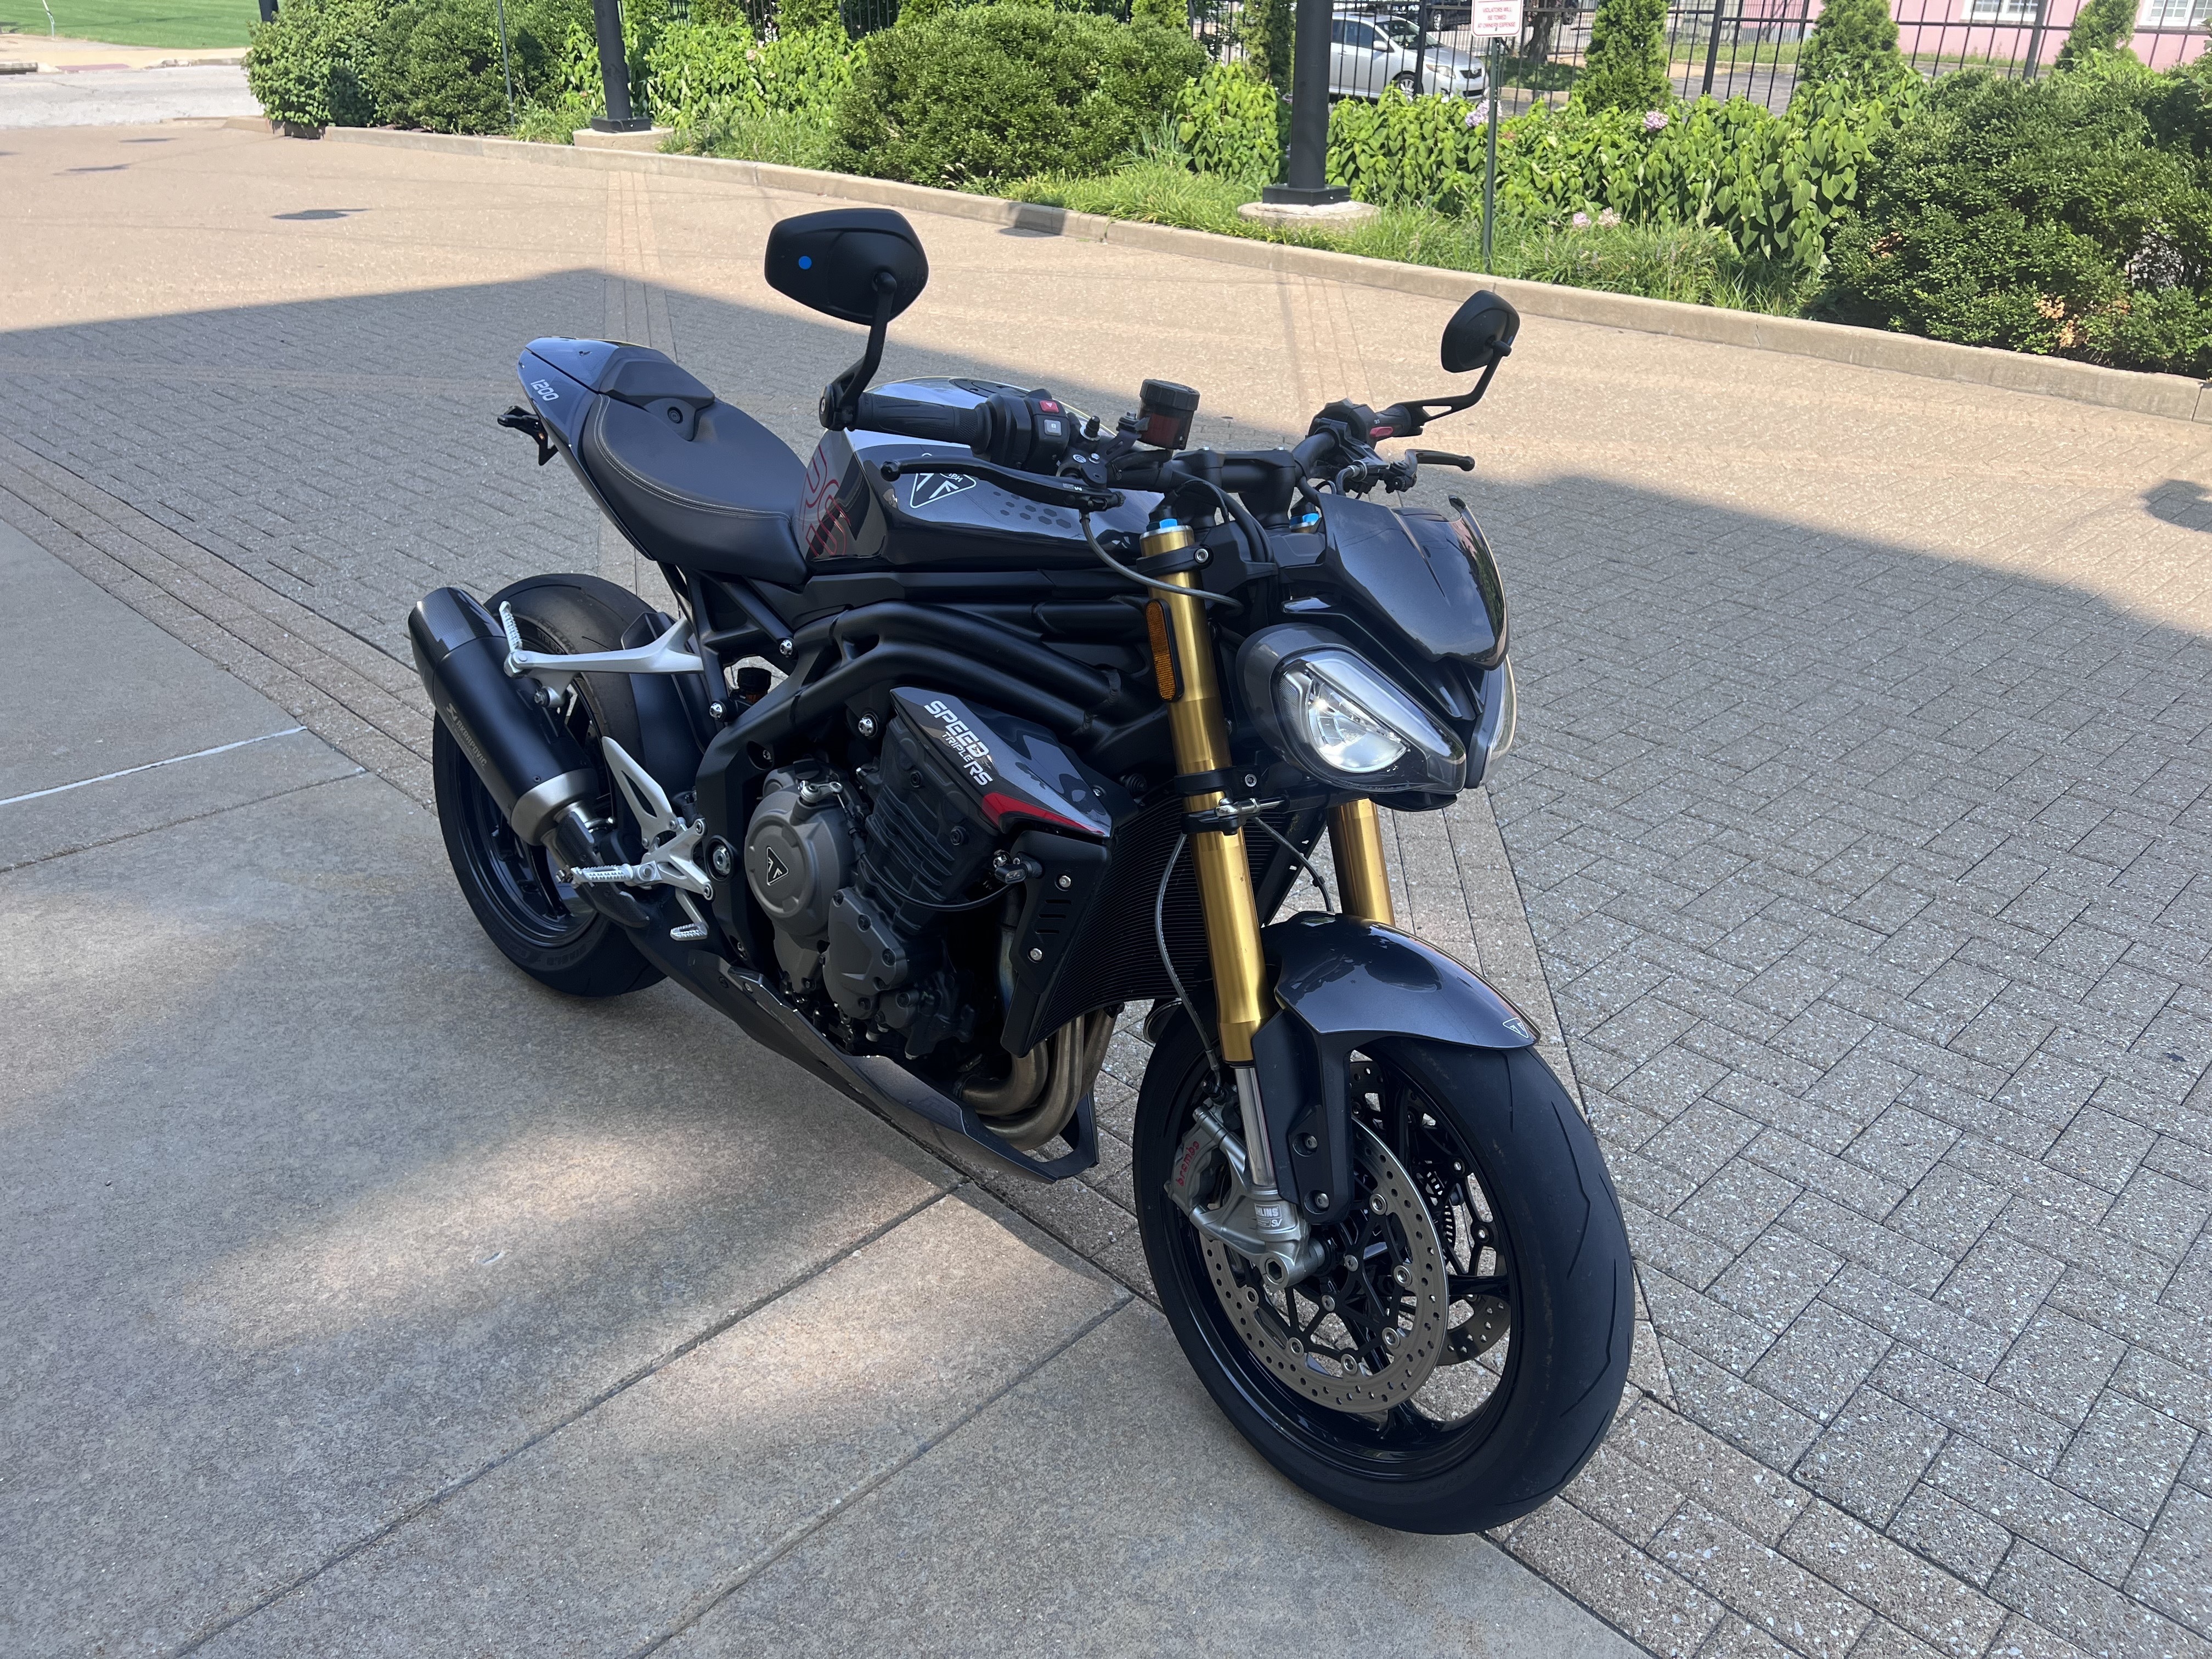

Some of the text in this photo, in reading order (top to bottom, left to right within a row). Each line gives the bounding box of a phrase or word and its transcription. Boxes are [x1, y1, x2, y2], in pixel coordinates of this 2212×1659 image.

[530, 379, 560, 401] 1200
[923, 699, 990, 758] SPEED
[941, 731, 994, 786] TRIPLE RS
[1175, 1141, 1200, 1187] brembo
